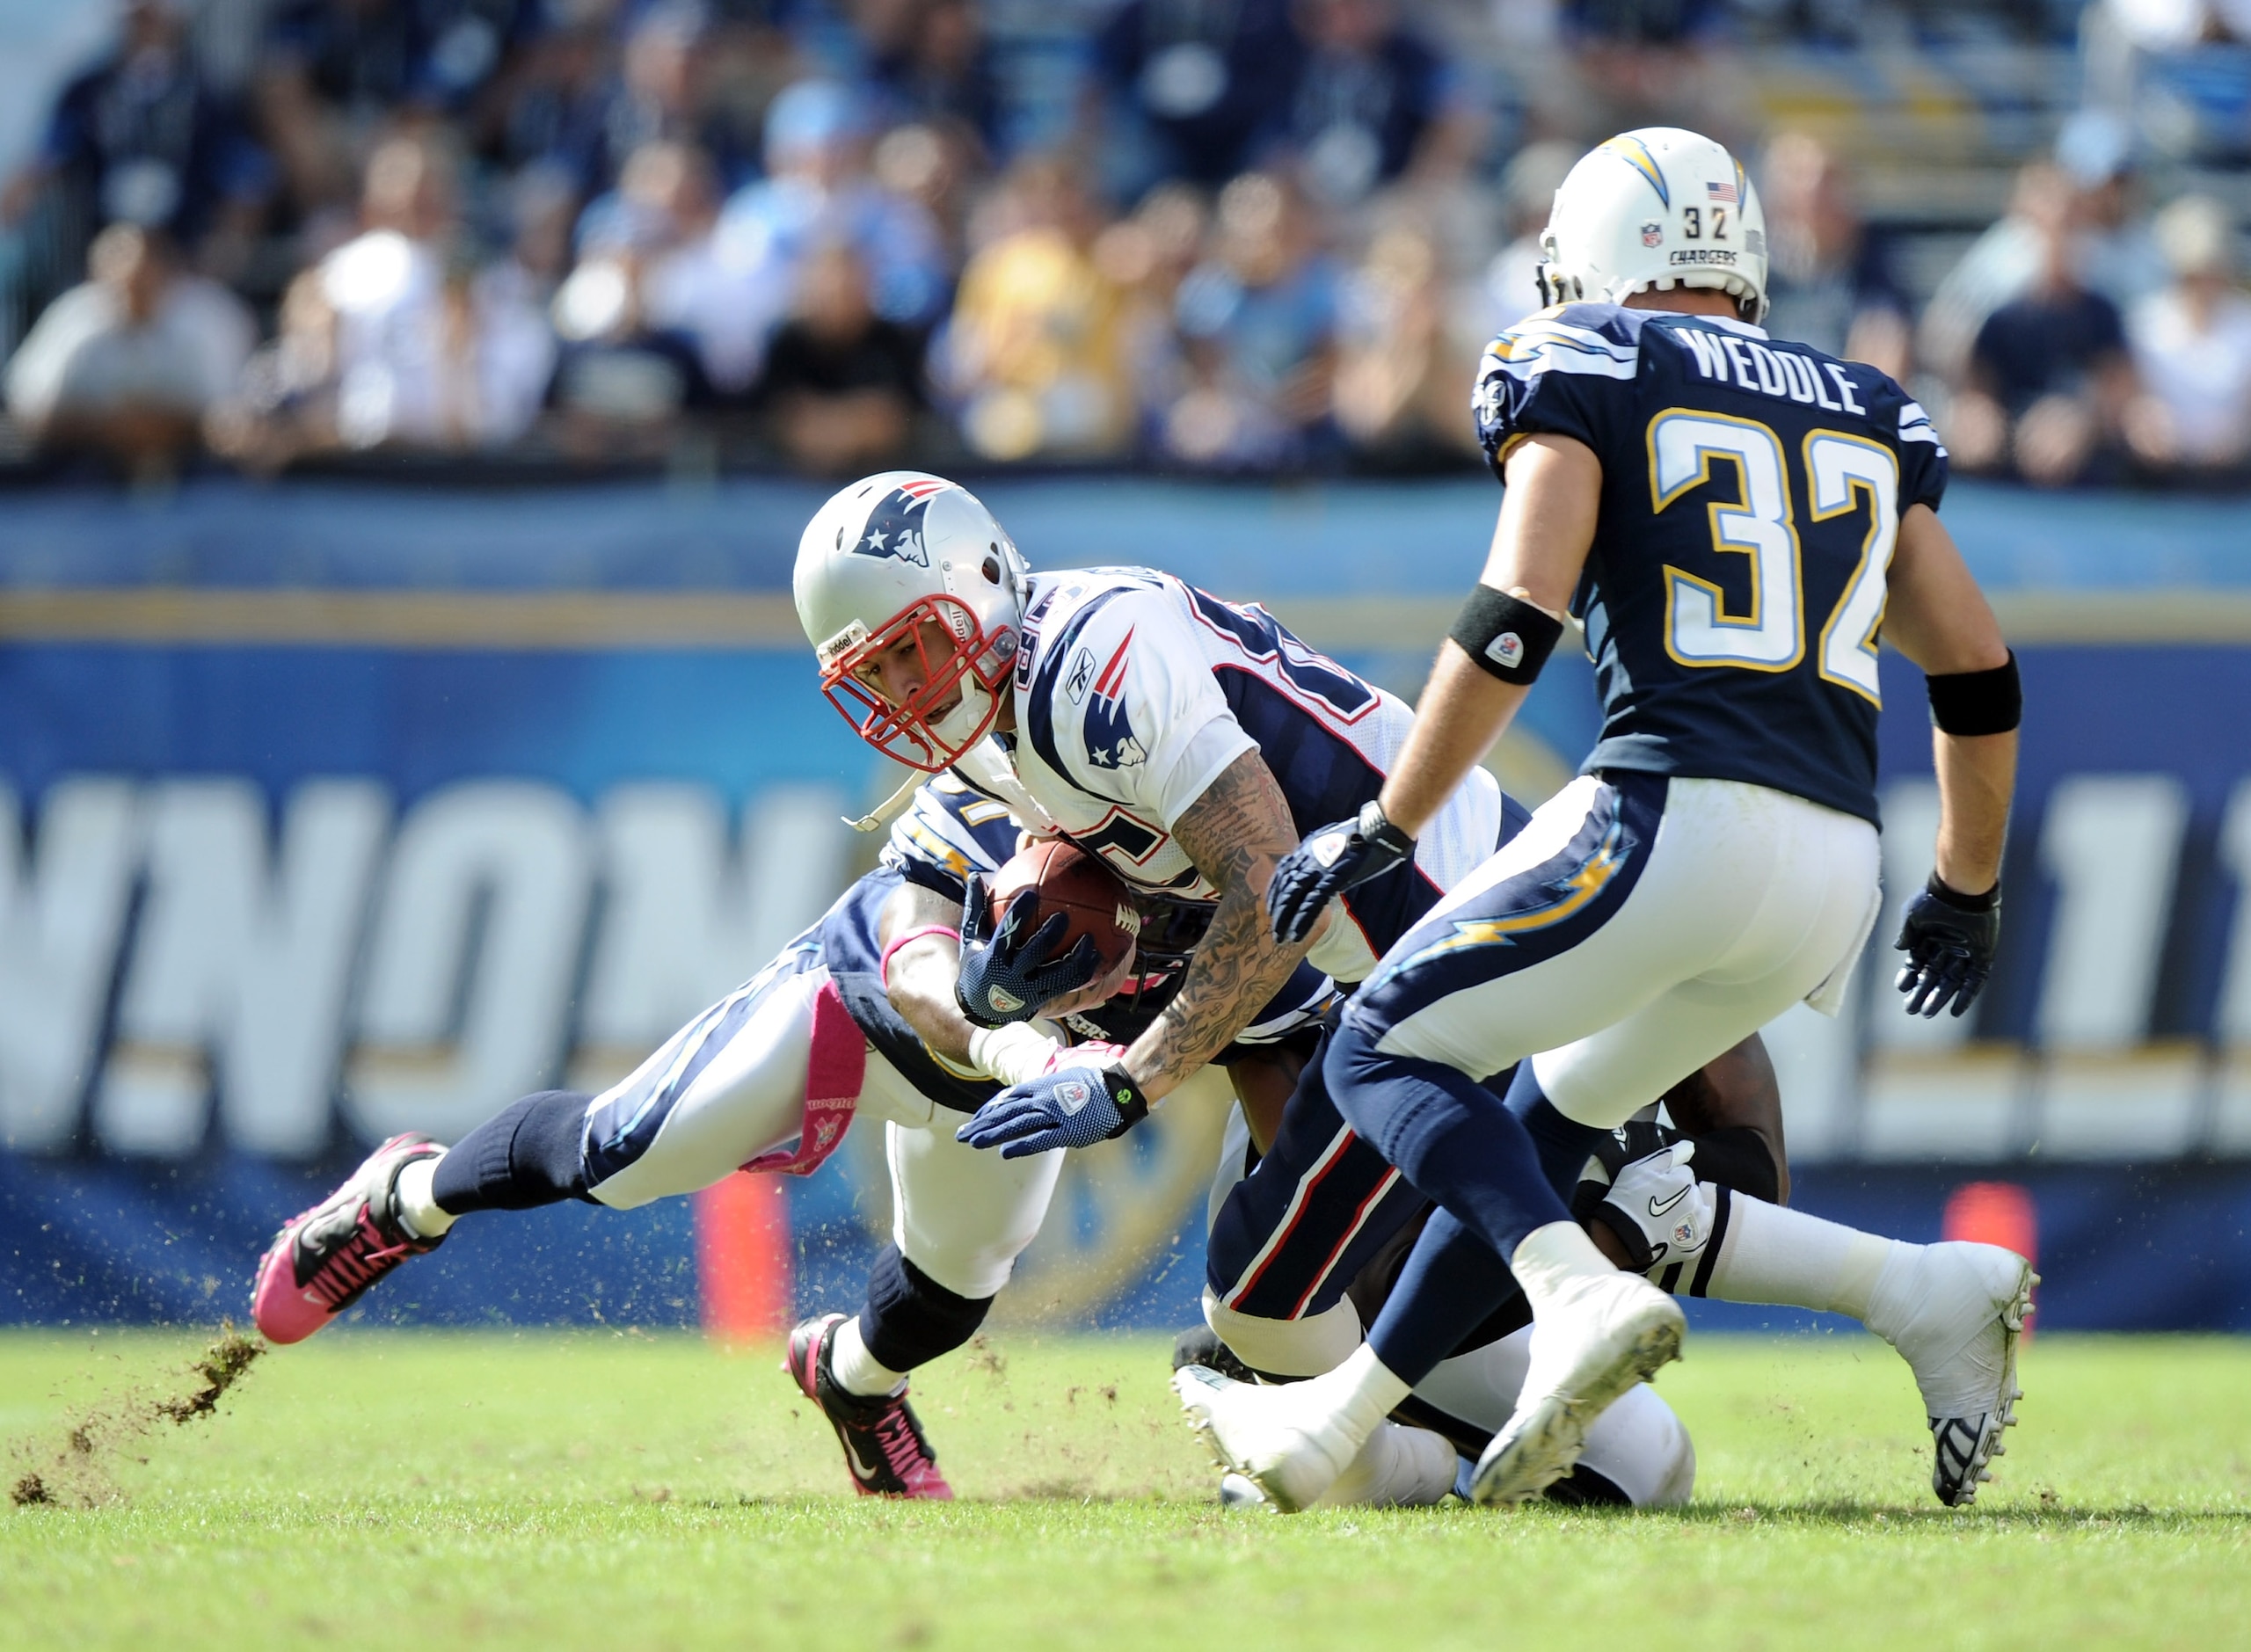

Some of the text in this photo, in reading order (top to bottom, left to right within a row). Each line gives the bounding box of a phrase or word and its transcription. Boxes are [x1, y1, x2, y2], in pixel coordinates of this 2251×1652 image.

[1684, 207, 1727, 240] 32
[1670, 250, 1737, 266] CHARGERS
[1673, 327, 1866, 416] WEDDLE
[1646, 407, 1899, 711] 32
